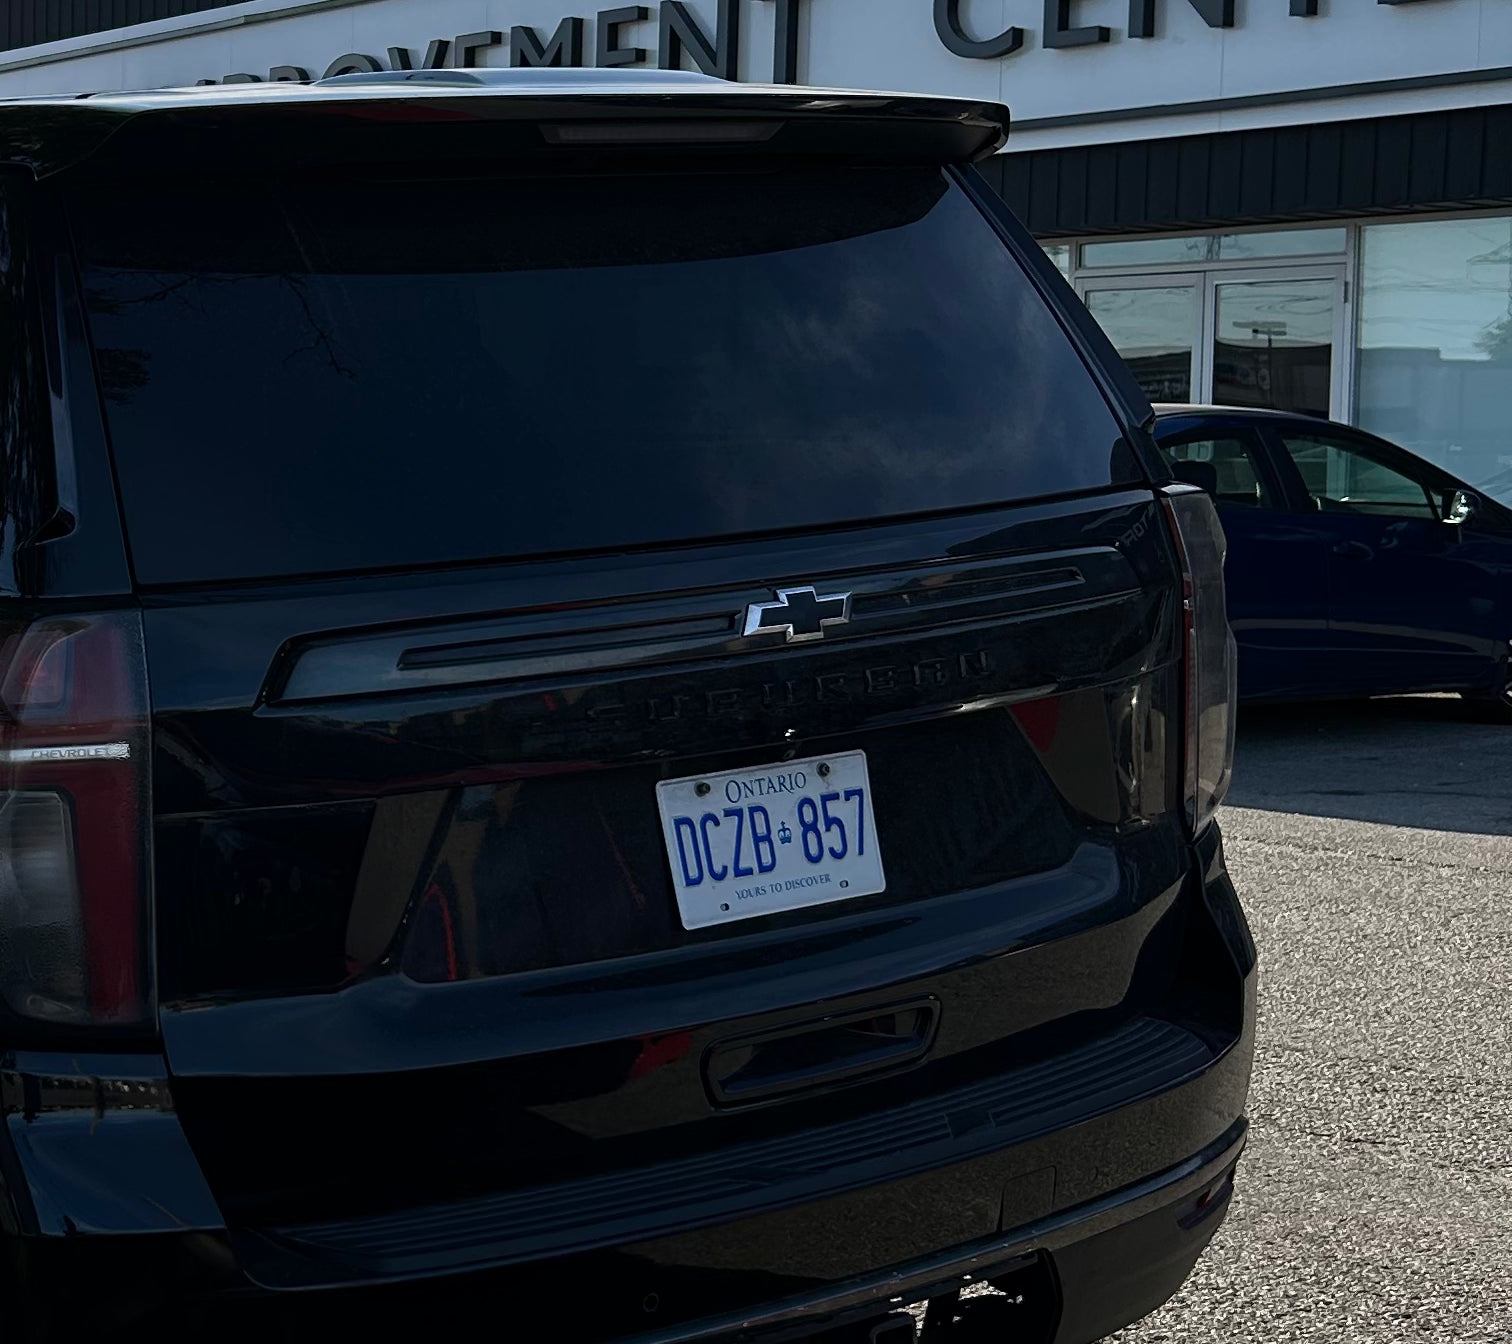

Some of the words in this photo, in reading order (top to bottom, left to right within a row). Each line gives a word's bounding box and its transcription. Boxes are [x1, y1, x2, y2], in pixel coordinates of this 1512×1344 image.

[31, 746, 113, 759] CHEVROLE
[725, 771, 807, 803] ONTARIO
[672, 805, 777, 887] DCZB
[797, 788, 864, 864] 857
[734, 885, 767, 900] YOURS
[769, 882, 783, 893] TO
[785, 873, 832, 891] DISCOVER
